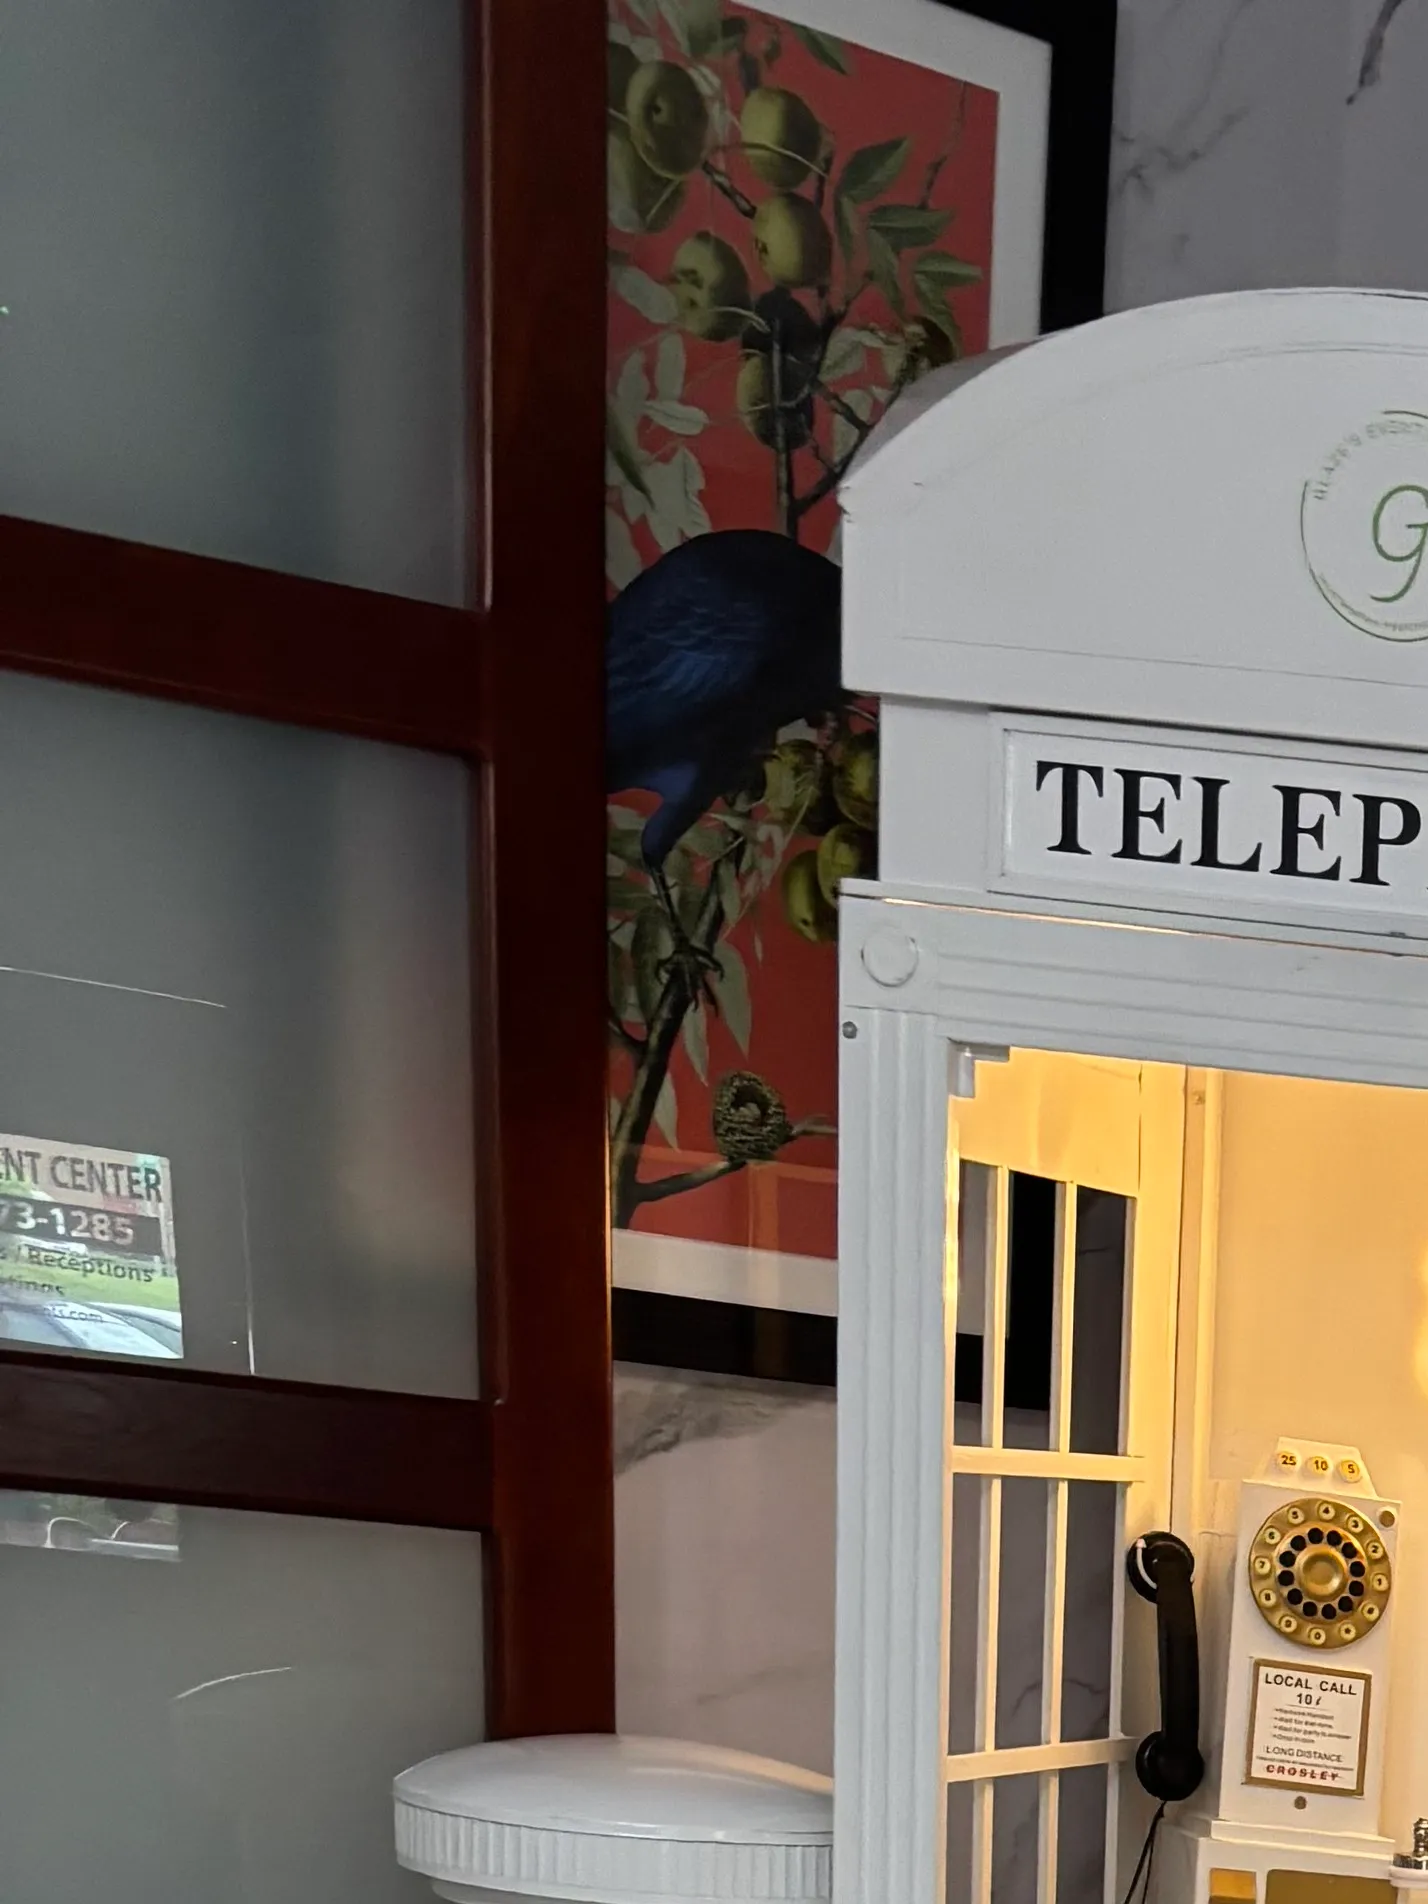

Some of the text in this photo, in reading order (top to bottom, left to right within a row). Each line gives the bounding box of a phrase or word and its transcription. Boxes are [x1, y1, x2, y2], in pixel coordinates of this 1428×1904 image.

[50, 1155, 162, 1203] CENTER
[1281, 1455, 1356, 1474] 25 10 5
[1265, 1673, 1357, 1695] LOCAL CALL
[1266, 1746, 1343, 1763] LONG DISTANCE
[1266, 1765, 1340, 1781] CROSLEY
